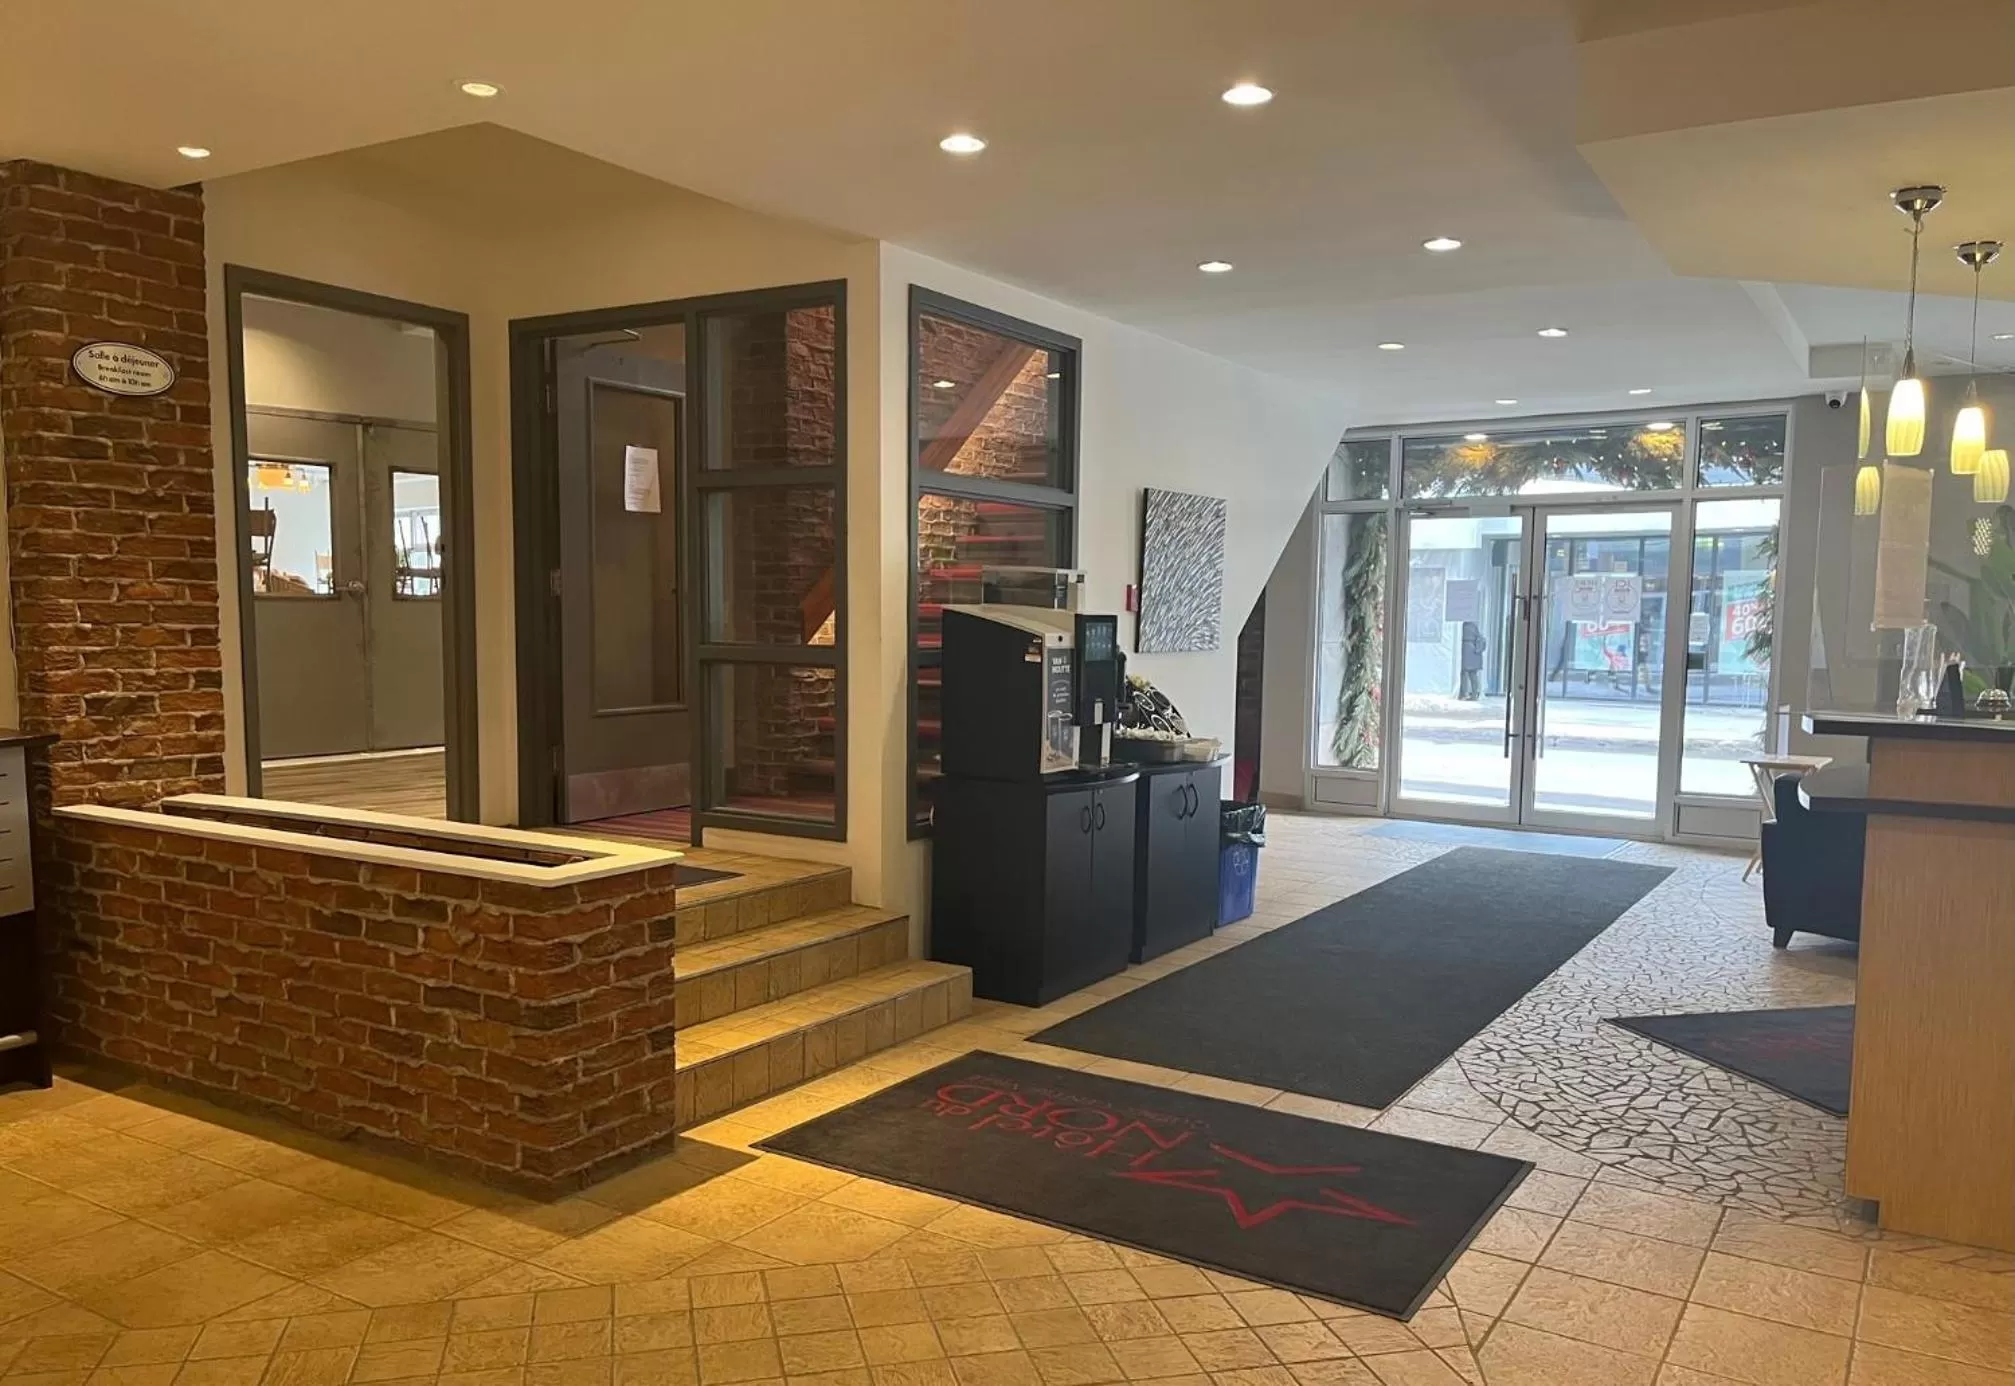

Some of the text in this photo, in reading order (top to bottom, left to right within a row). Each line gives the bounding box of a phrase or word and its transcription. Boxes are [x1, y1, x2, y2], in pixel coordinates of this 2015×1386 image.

[88, 350, 110, 360] Salle
[121, 354, 159, 369] déjeuner
[97, 364, 151, 377] Breakfast room
[920, 1098, 972, 1117] du
[936, 1084, 1194, 1150] NORD
[968, 1114, 1163, 1166] Hôtel
